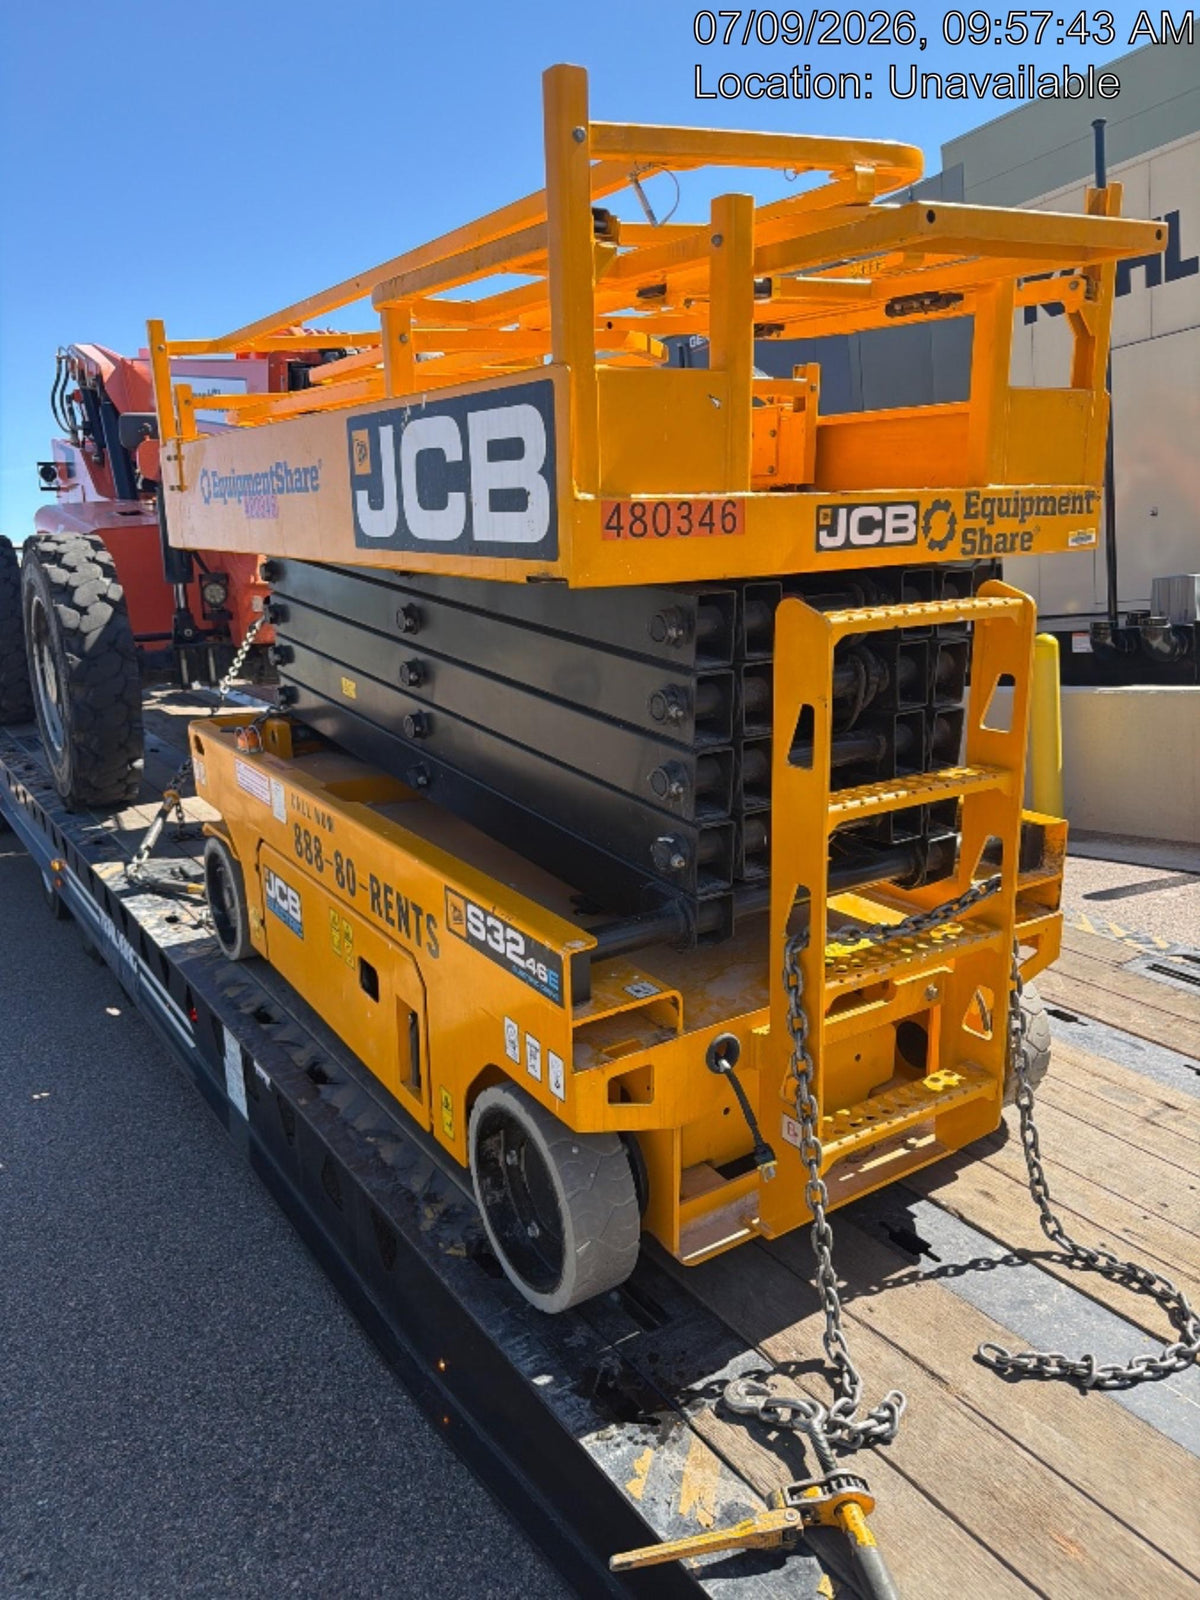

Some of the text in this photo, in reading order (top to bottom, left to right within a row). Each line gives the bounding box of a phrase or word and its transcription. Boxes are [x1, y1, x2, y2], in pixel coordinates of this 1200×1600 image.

[211, 461, 320, 505] EquipmentShare
[355, 402, 552, 544] JCB
[603, 500, 738, 539] 480346
[819, 504, 917, 547] JCB
[963, 490, 1095, 526] Equipment
[960, 526, 1034, 556] Share
[266, 869, 302, 922] JCB
[293, 821, 441, 960] 888-80-RENTS
